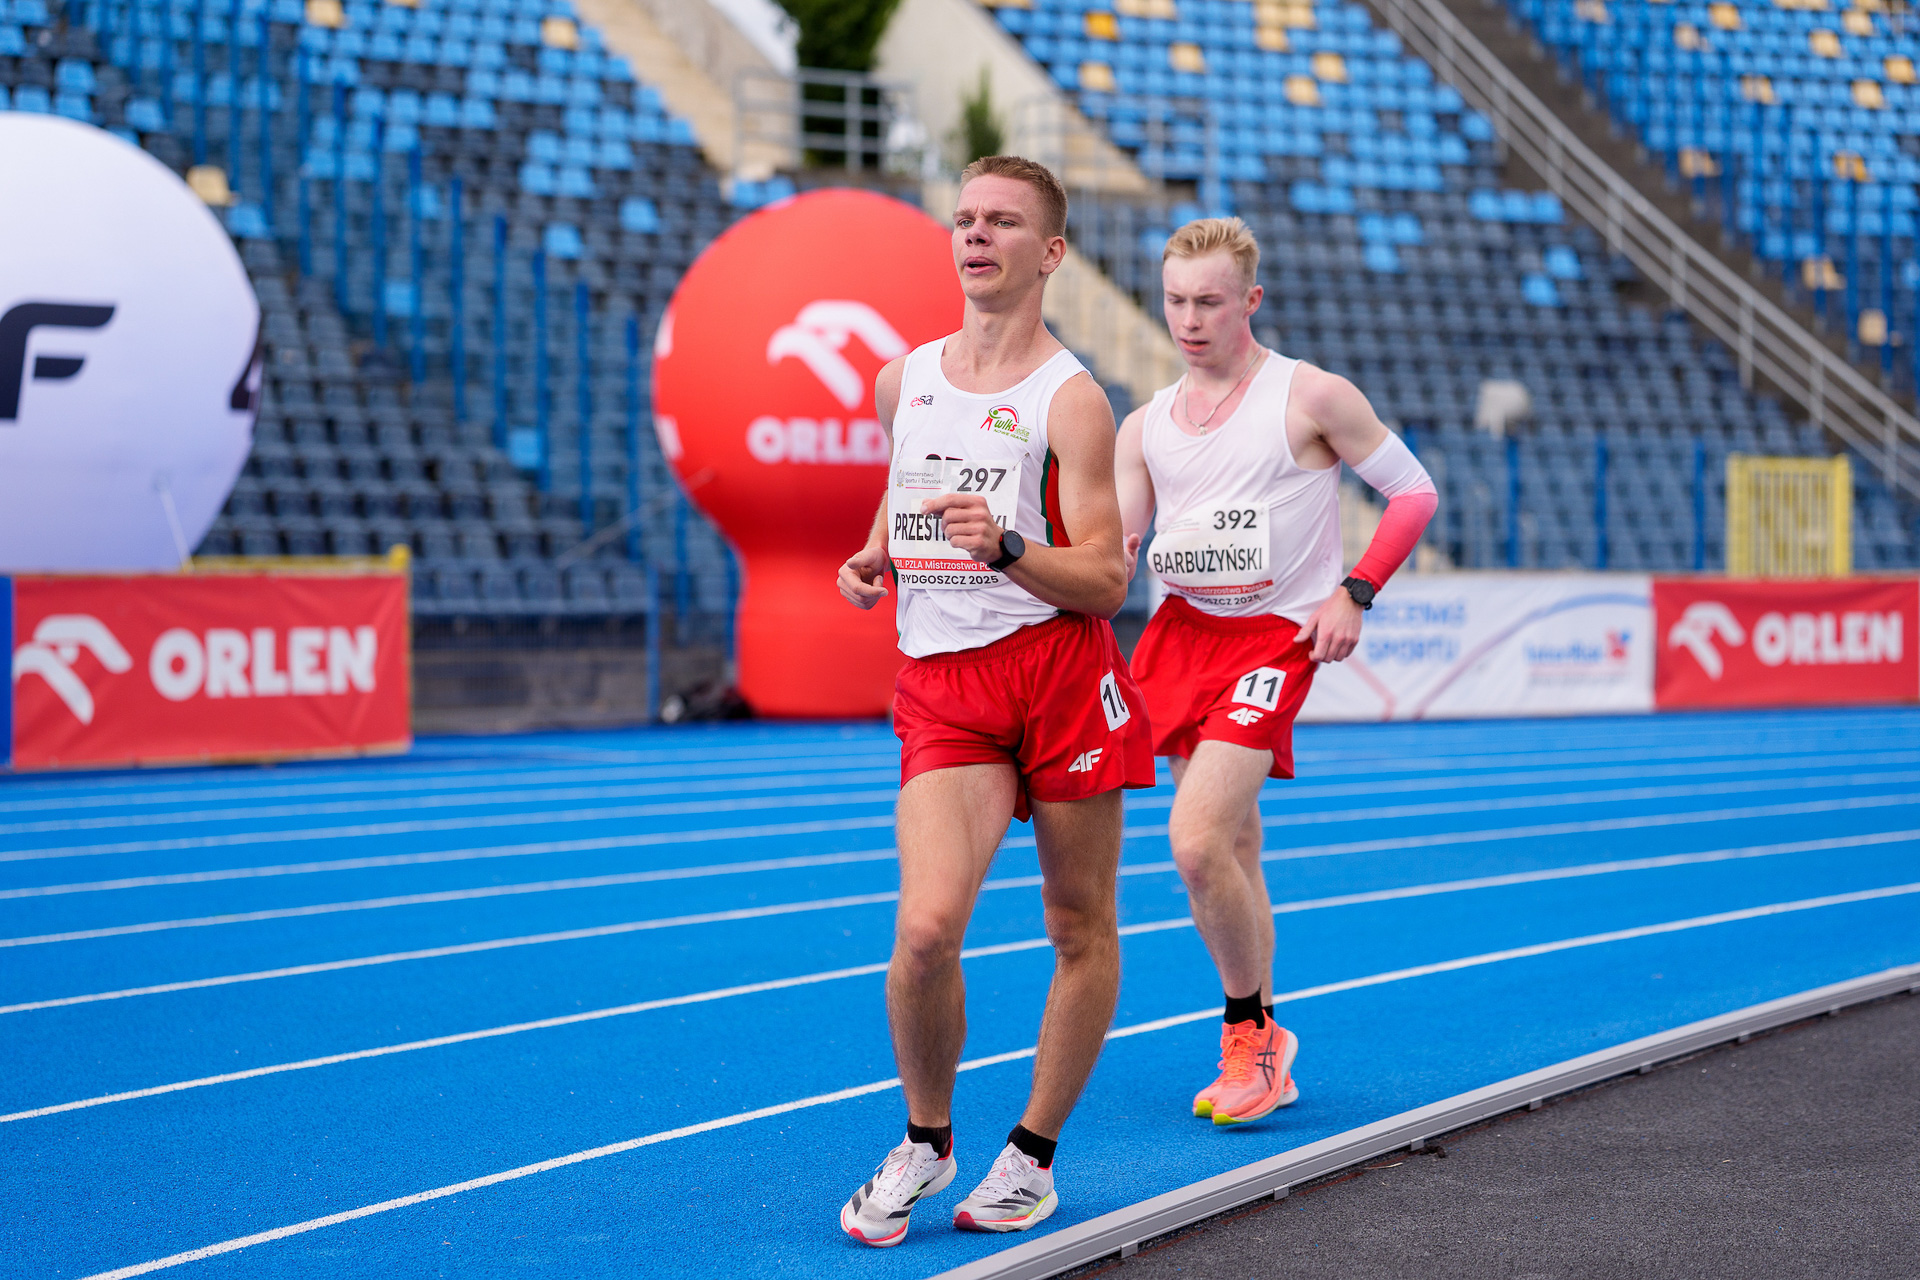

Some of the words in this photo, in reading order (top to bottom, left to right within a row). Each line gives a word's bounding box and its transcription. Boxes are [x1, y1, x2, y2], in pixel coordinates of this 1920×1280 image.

[746, 415, 890, 465] ORLE
[957, 468, 1007, 492] 297
[1213, 509, 1257, 530] 392
[905, 560, 923, 569] PZLA
[925, 560, 978, 570] Mistrzostwa
[1153, 544, 1263, 574] BARBUŻYŃSKI
[901, 574, 967, 585] BYDGOSZCZ
[969, 575, 999, 585] 2025
[1753, 611, 1903, 666] ORLEN
[149, 627, 377, 701] ORLEN
[1244, 673, 1279, 702] 11
[1227, 707, 1264, 726] 4F
[1068, 748, 1103, 773] 4F
